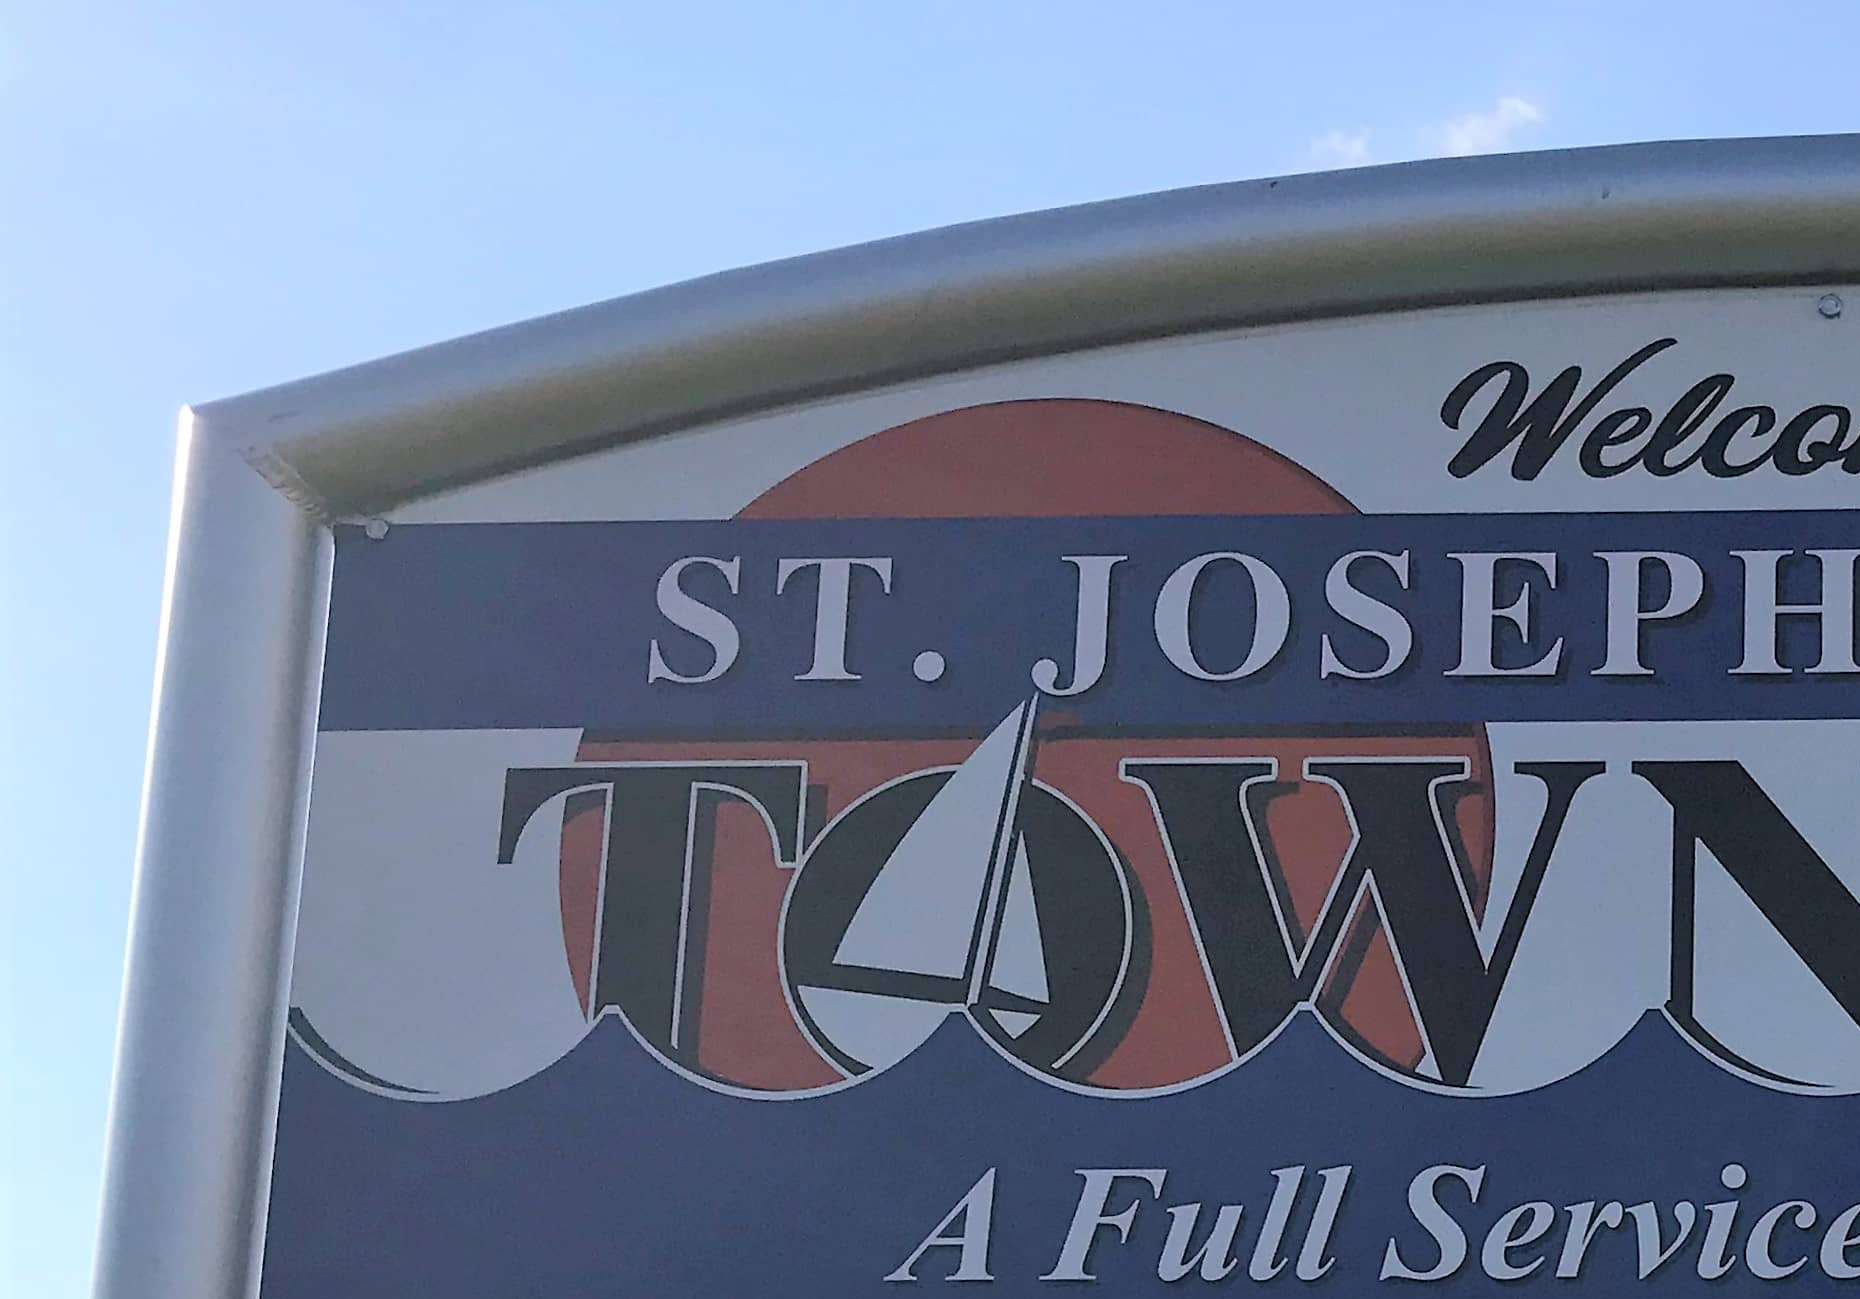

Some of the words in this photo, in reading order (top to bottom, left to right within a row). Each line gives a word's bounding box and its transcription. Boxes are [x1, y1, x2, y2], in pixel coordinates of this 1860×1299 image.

[646, 554, 946, 686] ST.
[887, 1167, 1000, 1283] A
[1040, 1165, 1347, 1283] Full
